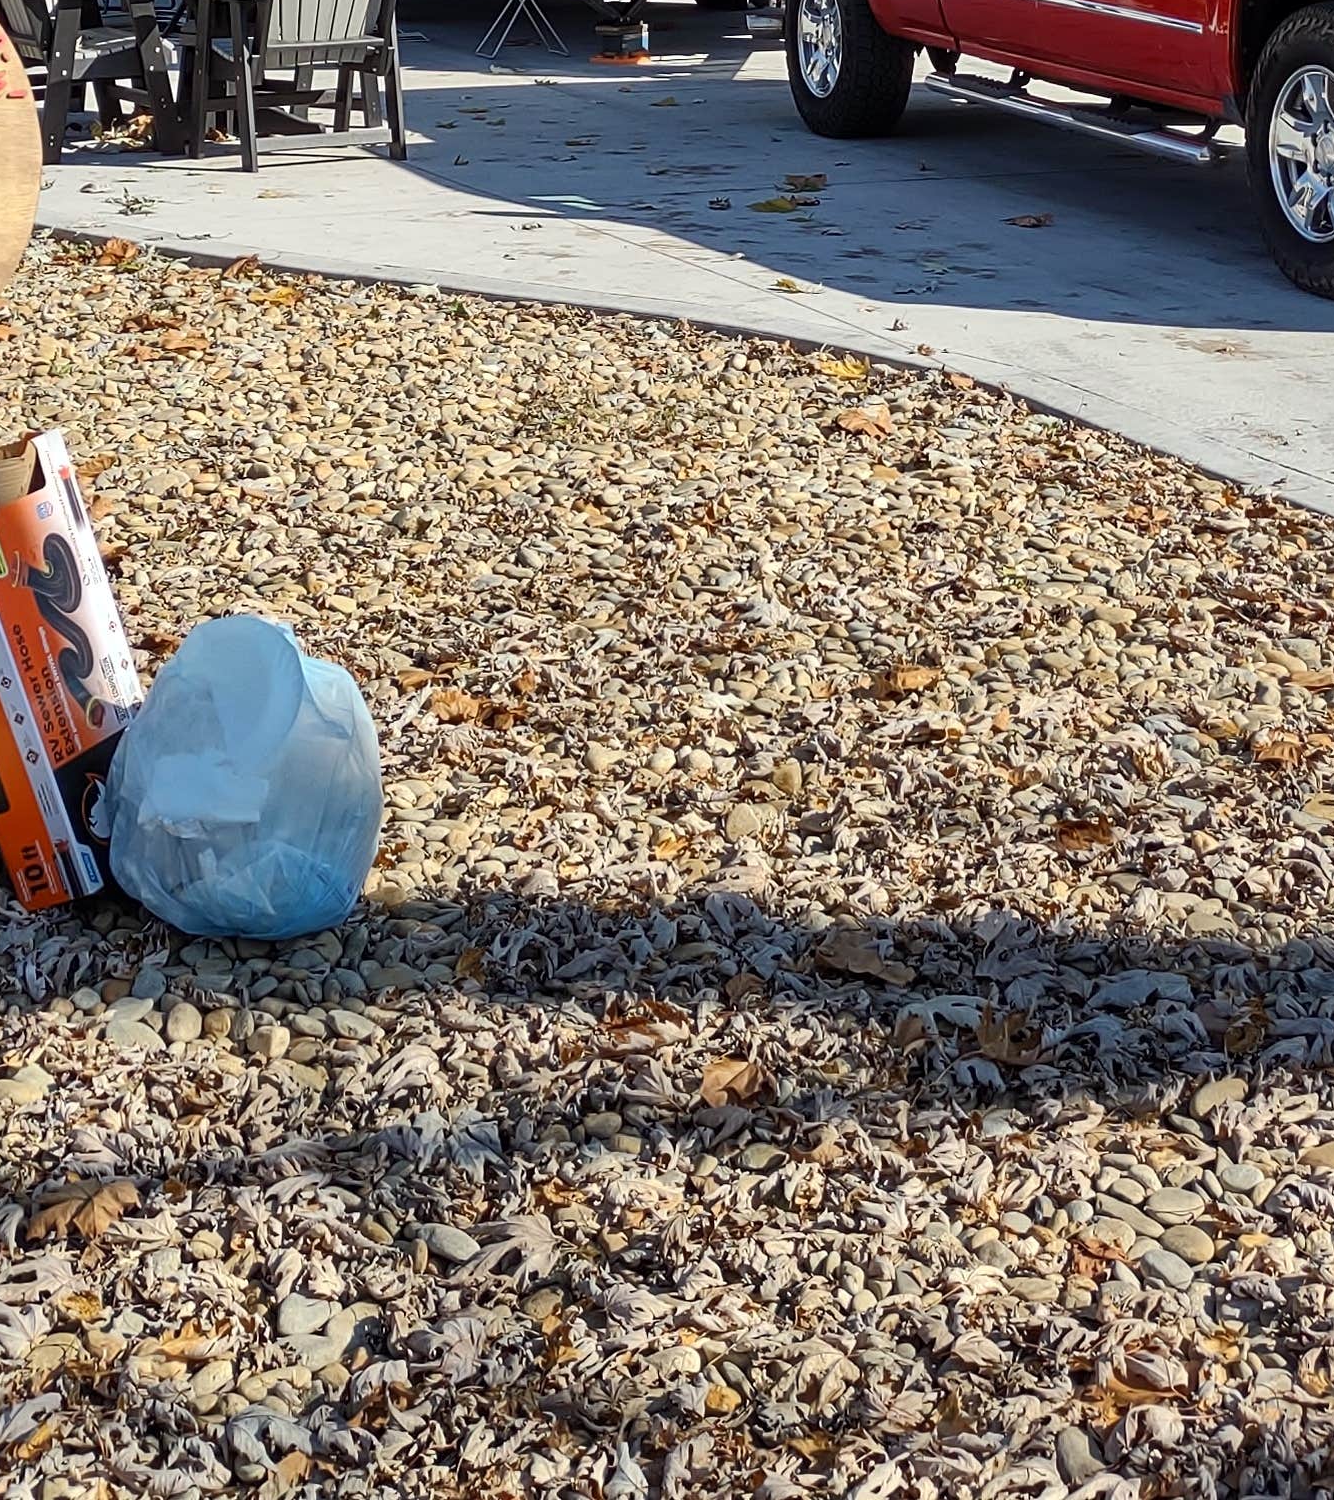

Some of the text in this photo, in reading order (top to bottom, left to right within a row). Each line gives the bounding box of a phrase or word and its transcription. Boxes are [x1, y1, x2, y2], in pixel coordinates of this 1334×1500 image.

[12, 624, 33, 671] Hose
[29, 676, 55, 734] Sewer
[41, 667, 75, 755] Extension
[48, 738, 64, 763] RV
[25, 866, 47, 894] 10
